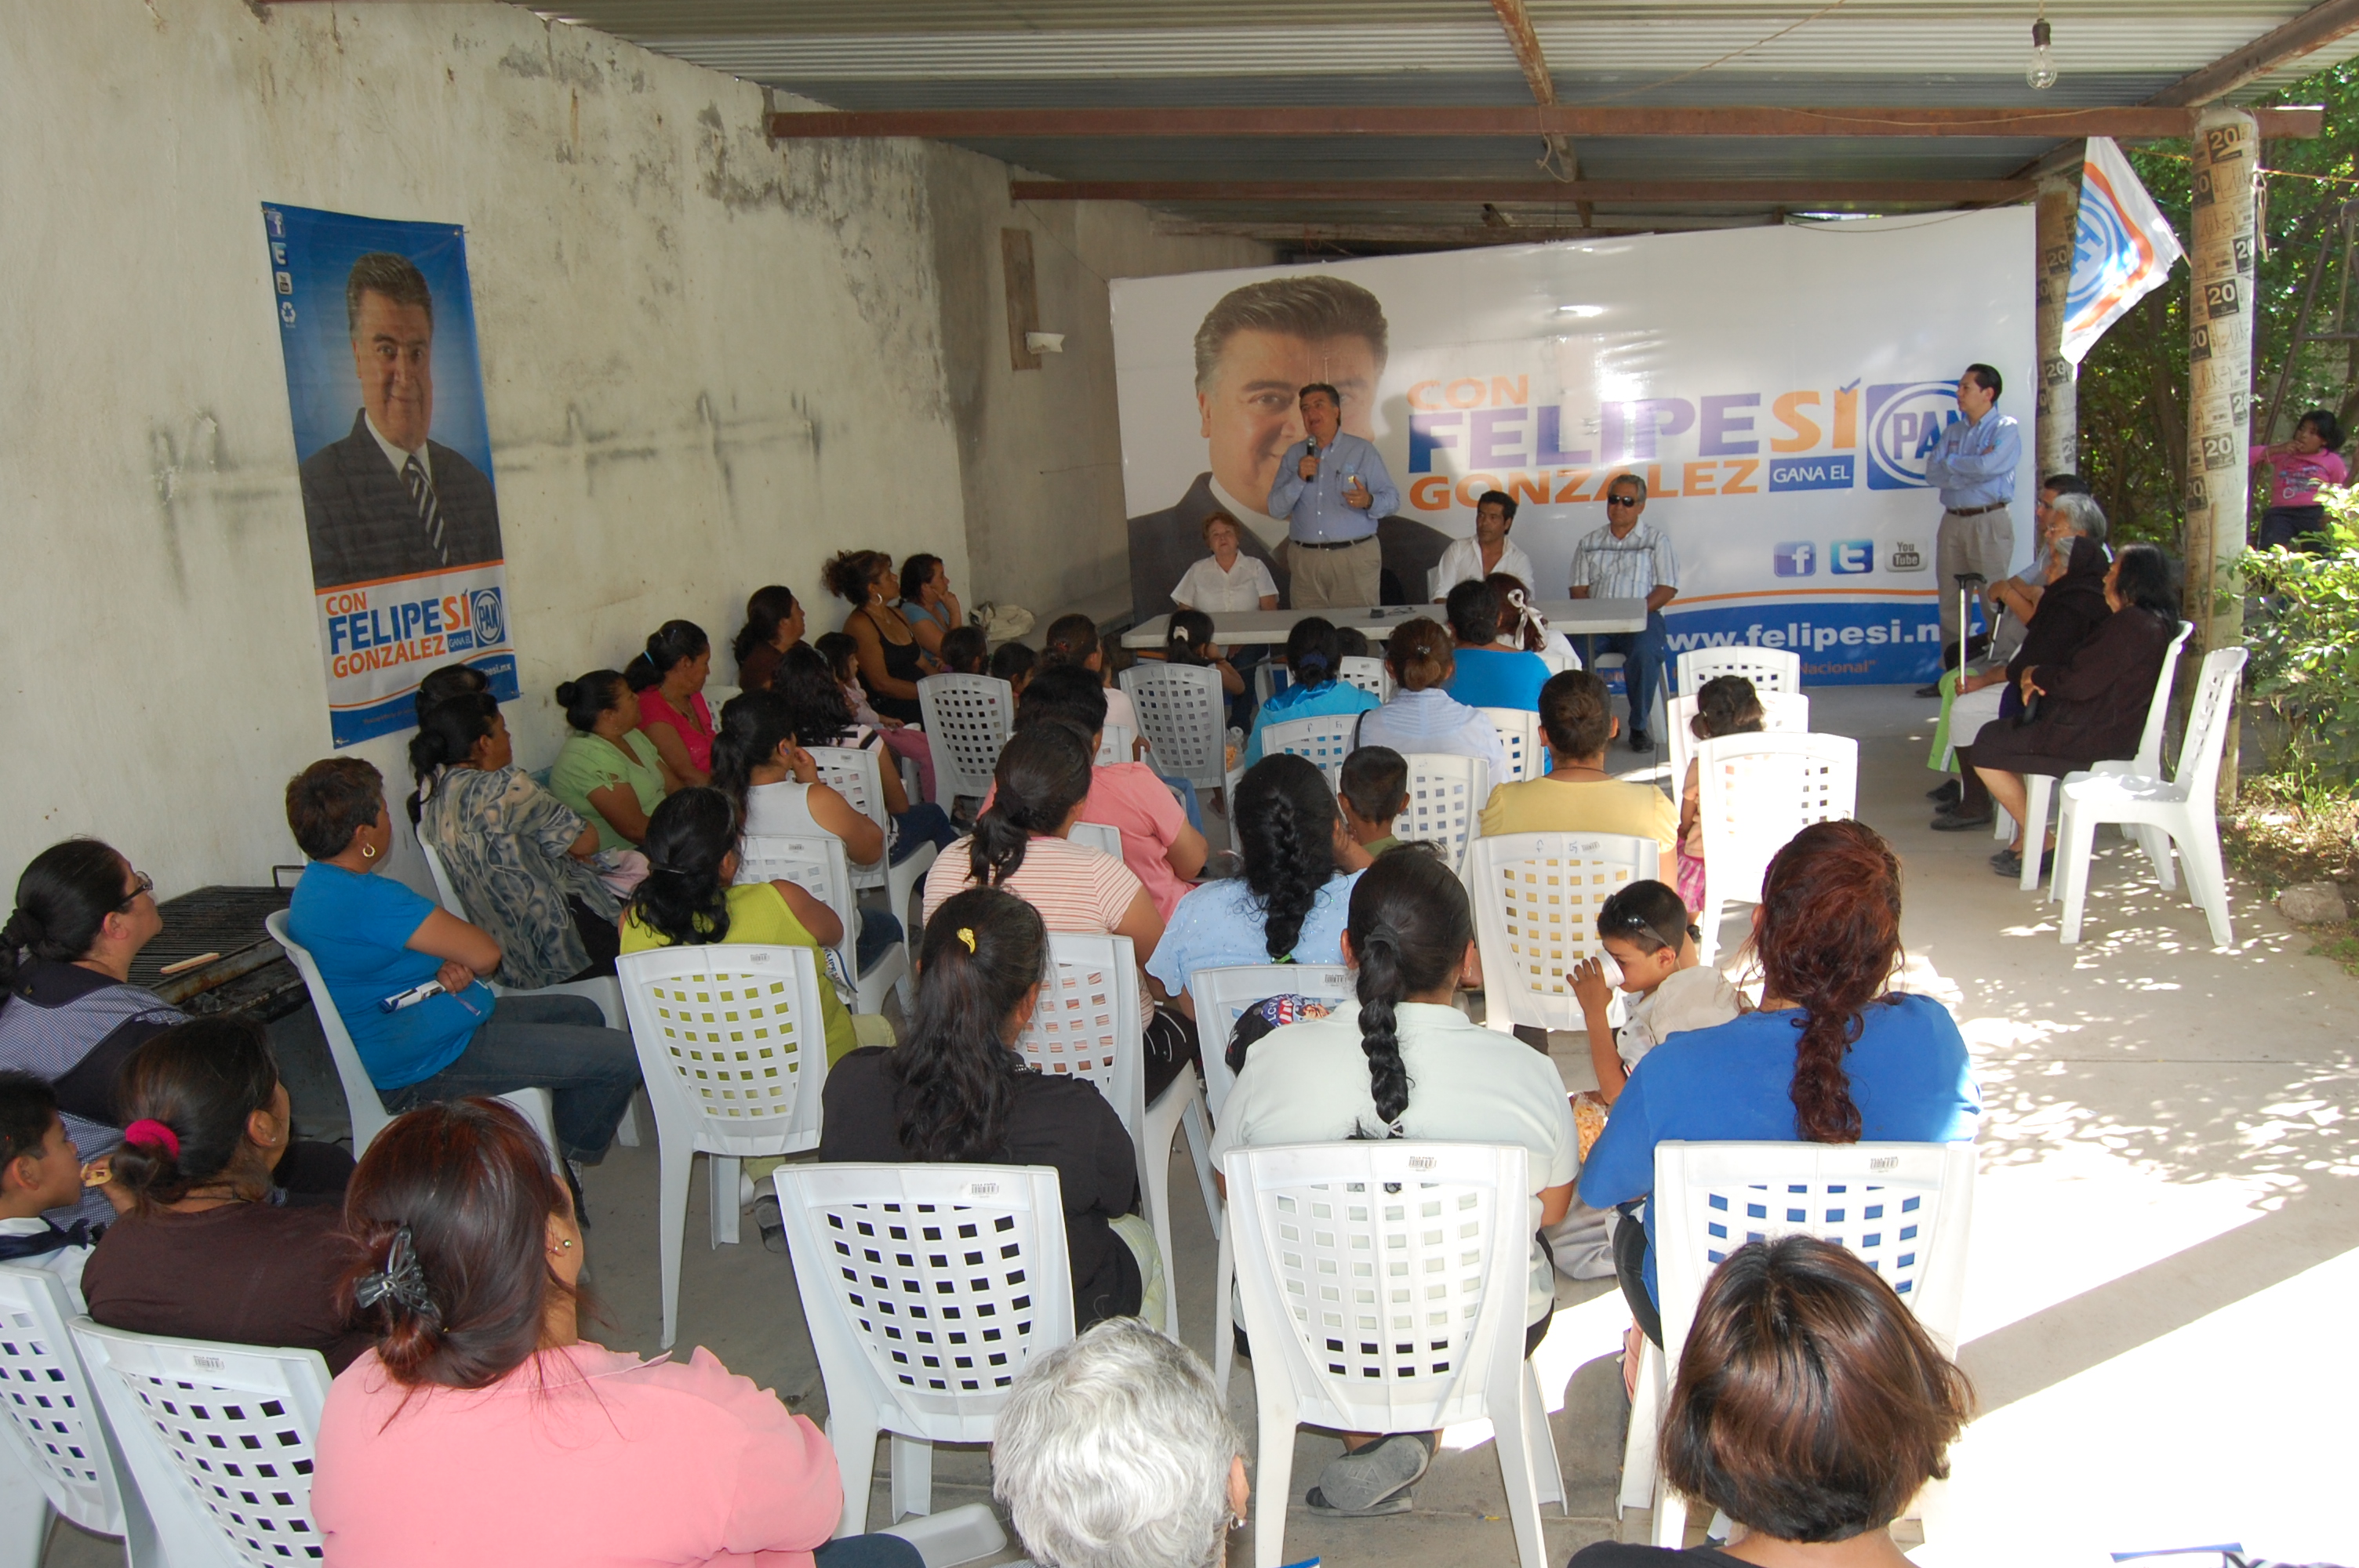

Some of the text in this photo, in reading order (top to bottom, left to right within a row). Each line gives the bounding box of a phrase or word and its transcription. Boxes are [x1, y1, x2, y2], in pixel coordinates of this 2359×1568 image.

[2210, 127, 2237, 151] 20
[2048, 250, 2068, 267] 20
[2208, 283, 2235, 306] 20
[2046, 361, 2066, 378] 20
[1407, 374, 1528, 410] CON
[1408, 393, 1761, 474] FELIPE
[2205, 436, 2232, 457] 20
[1773, 465, 1850, 483] GANA EL
[1839, 543, 1866, 572] t
[1896, 542, 1915, 552] You
[1791, 545, 1810, 574] f
[1895, 554, 1918, 565] Tube
[325, 592, 367, 615] CON
[328, 598, 442, 655] FELIPE
[478, 602, 499, 633] PAN
[449, 635, 472, 648] GANA EL
